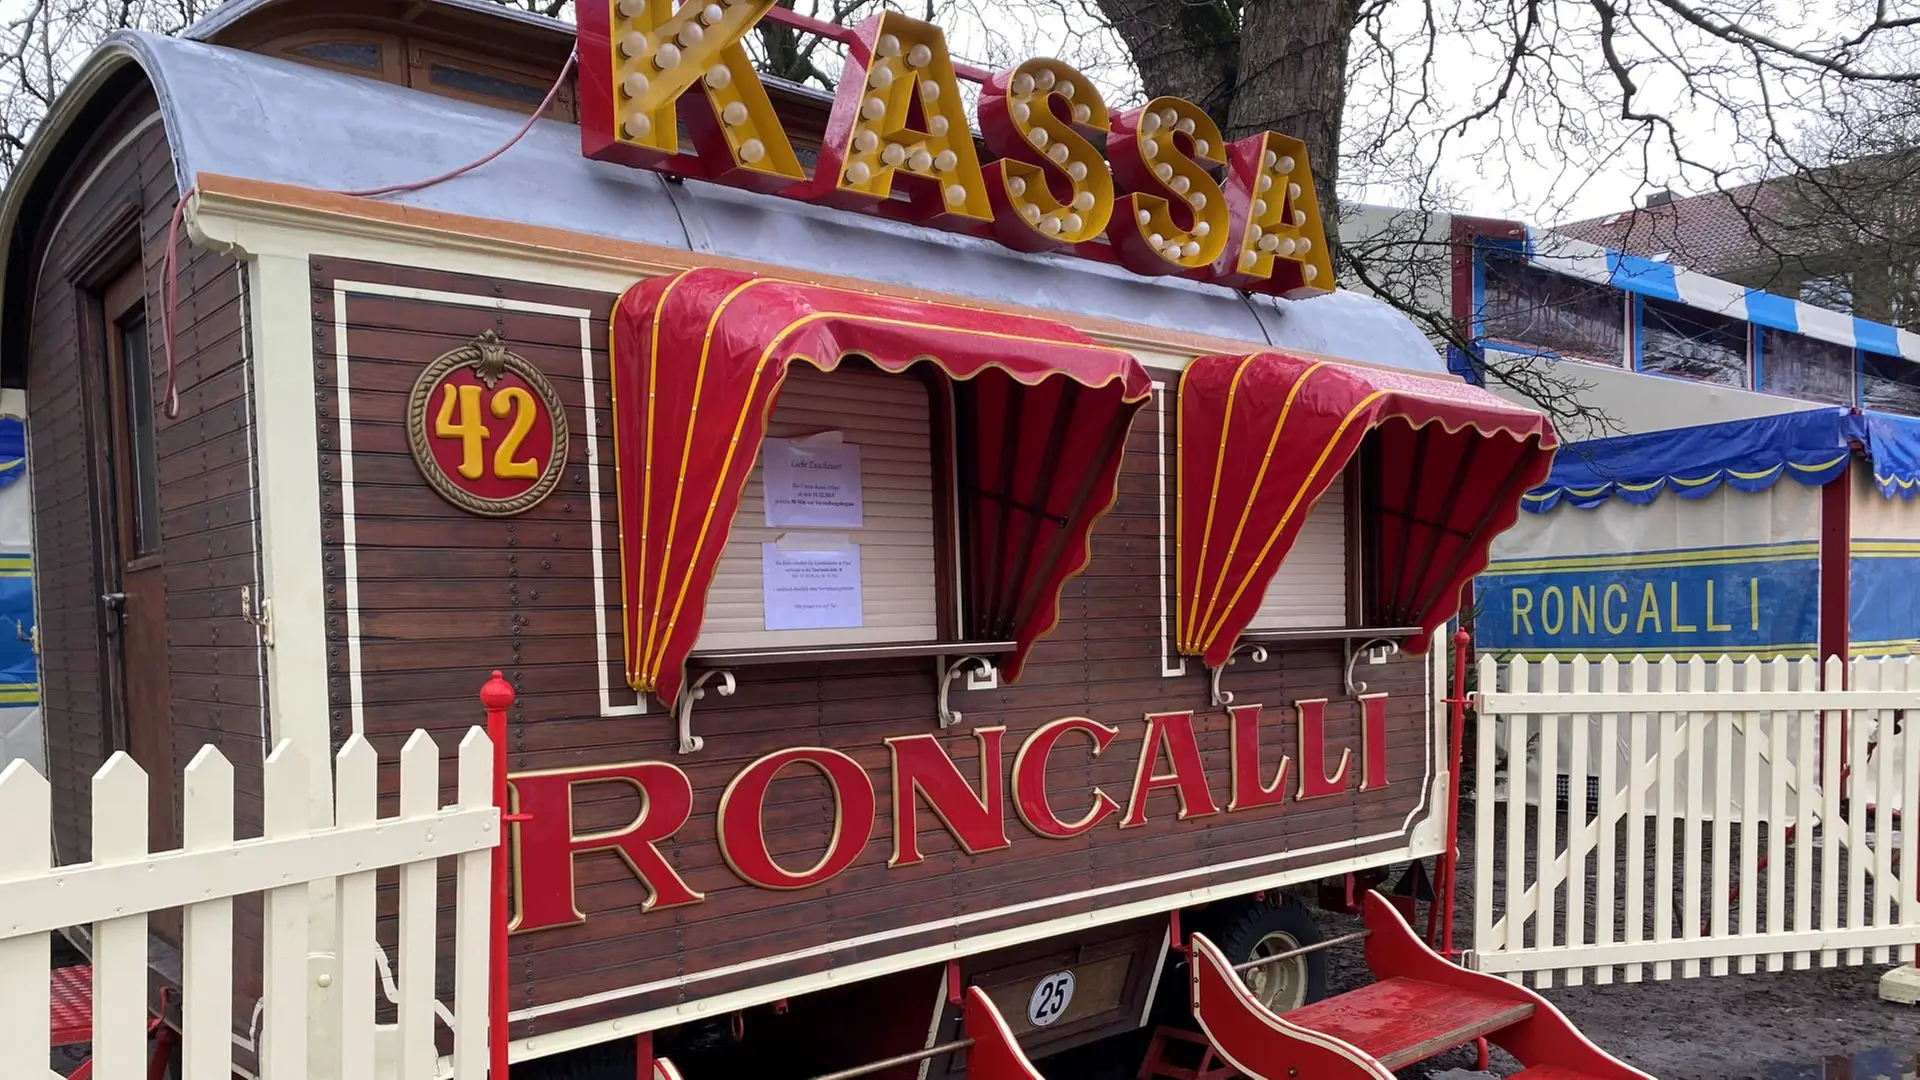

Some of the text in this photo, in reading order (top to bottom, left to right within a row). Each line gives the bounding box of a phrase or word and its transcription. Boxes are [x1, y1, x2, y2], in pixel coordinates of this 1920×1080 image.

[577, 0, 1336, 299] KASSA
[435, 383, 539, 480] 42
[1511, 577, 1759, 636] RONCALLI
[507, 691, 1390, 935] RONCALLI
[1035, 978, 1069, 1019] 25
